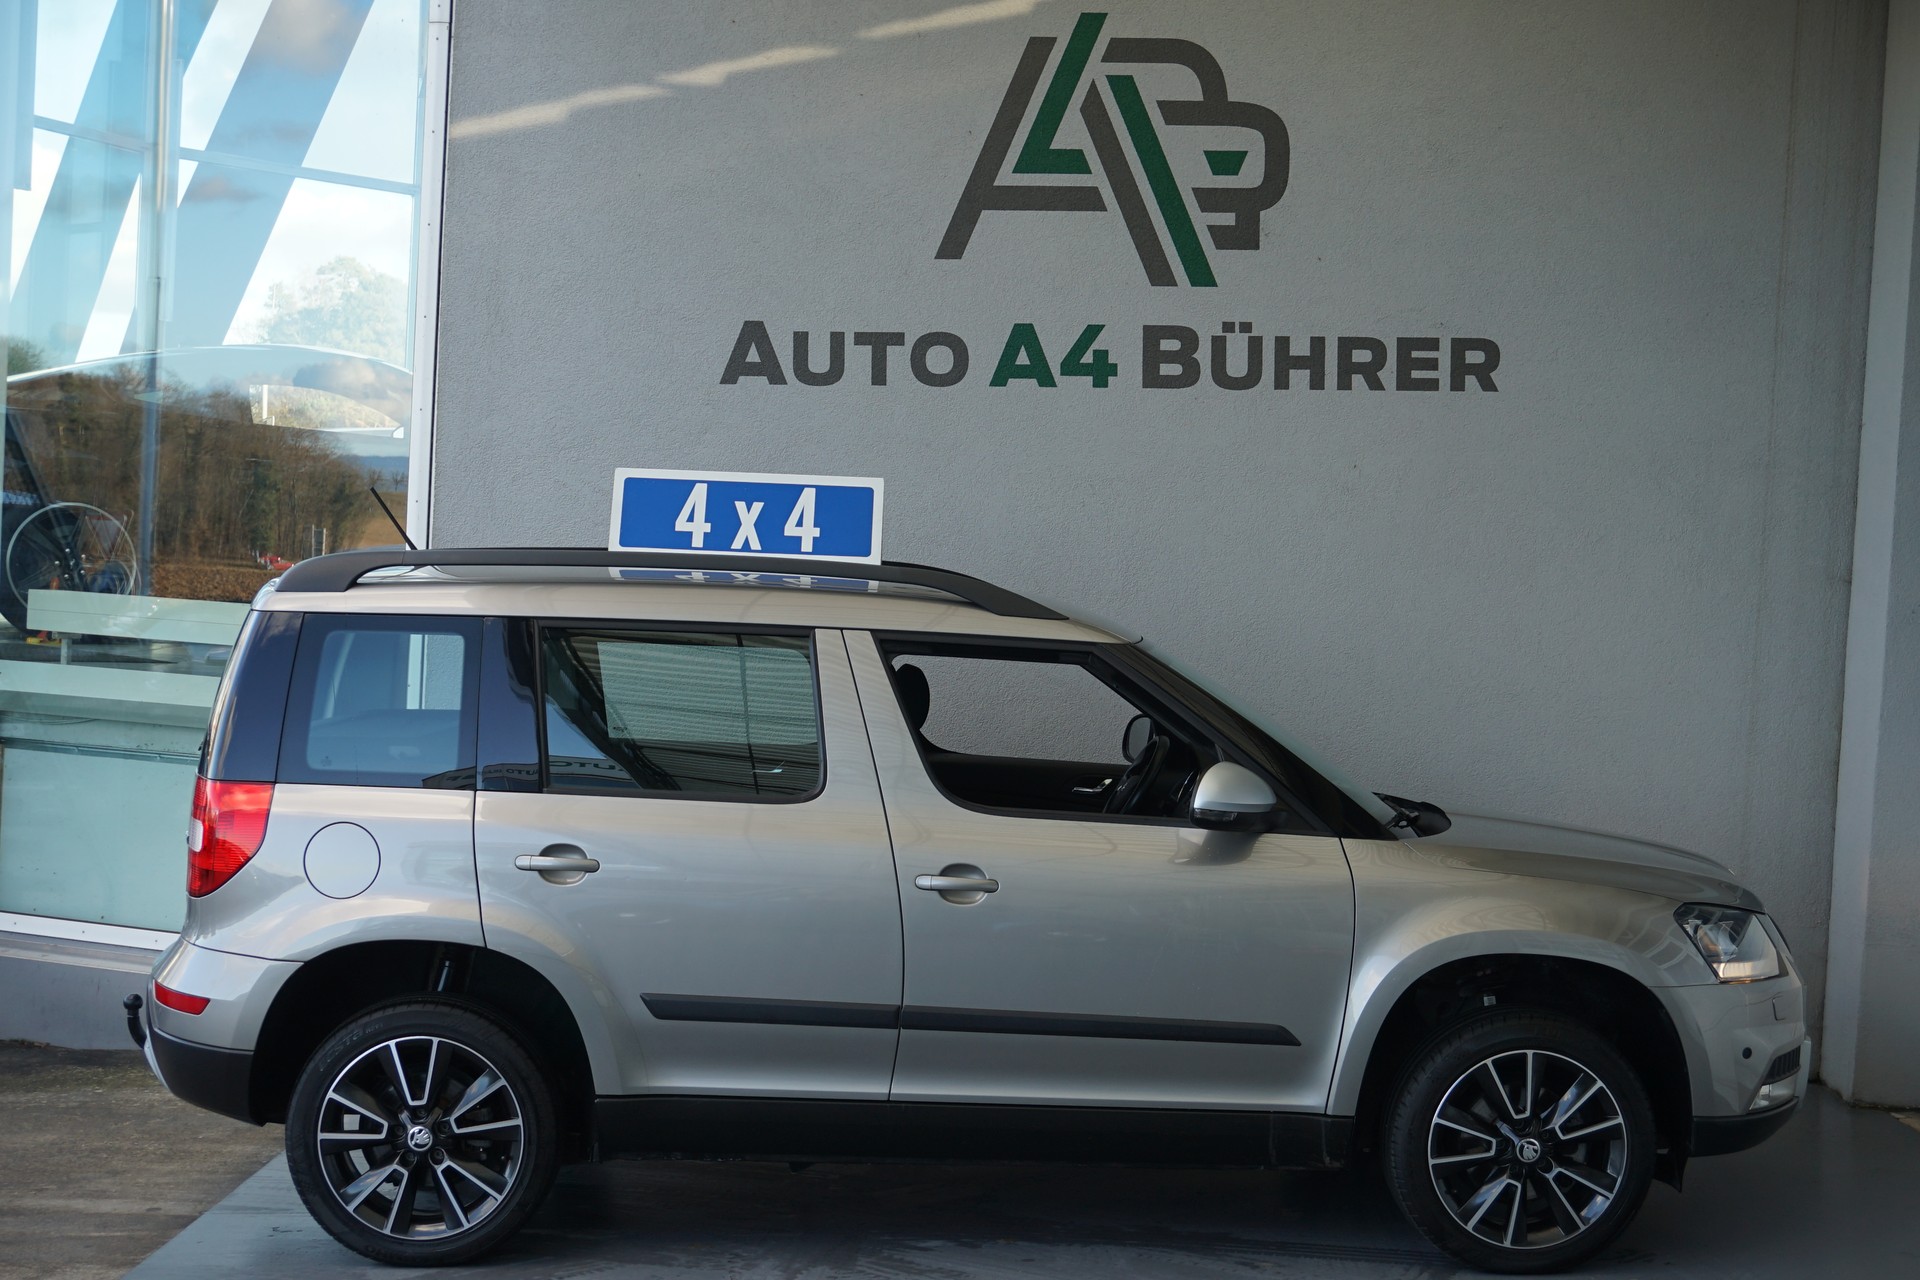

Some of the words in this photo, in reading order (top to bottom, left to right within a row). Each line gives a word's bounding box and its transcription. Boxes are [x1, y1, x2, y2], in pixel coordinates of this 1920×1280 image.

[720, 321, 969, 387] AUTO
[989, 323, 1118, 388] A4
[1142, 322, 1500, 392] BÜHRER
